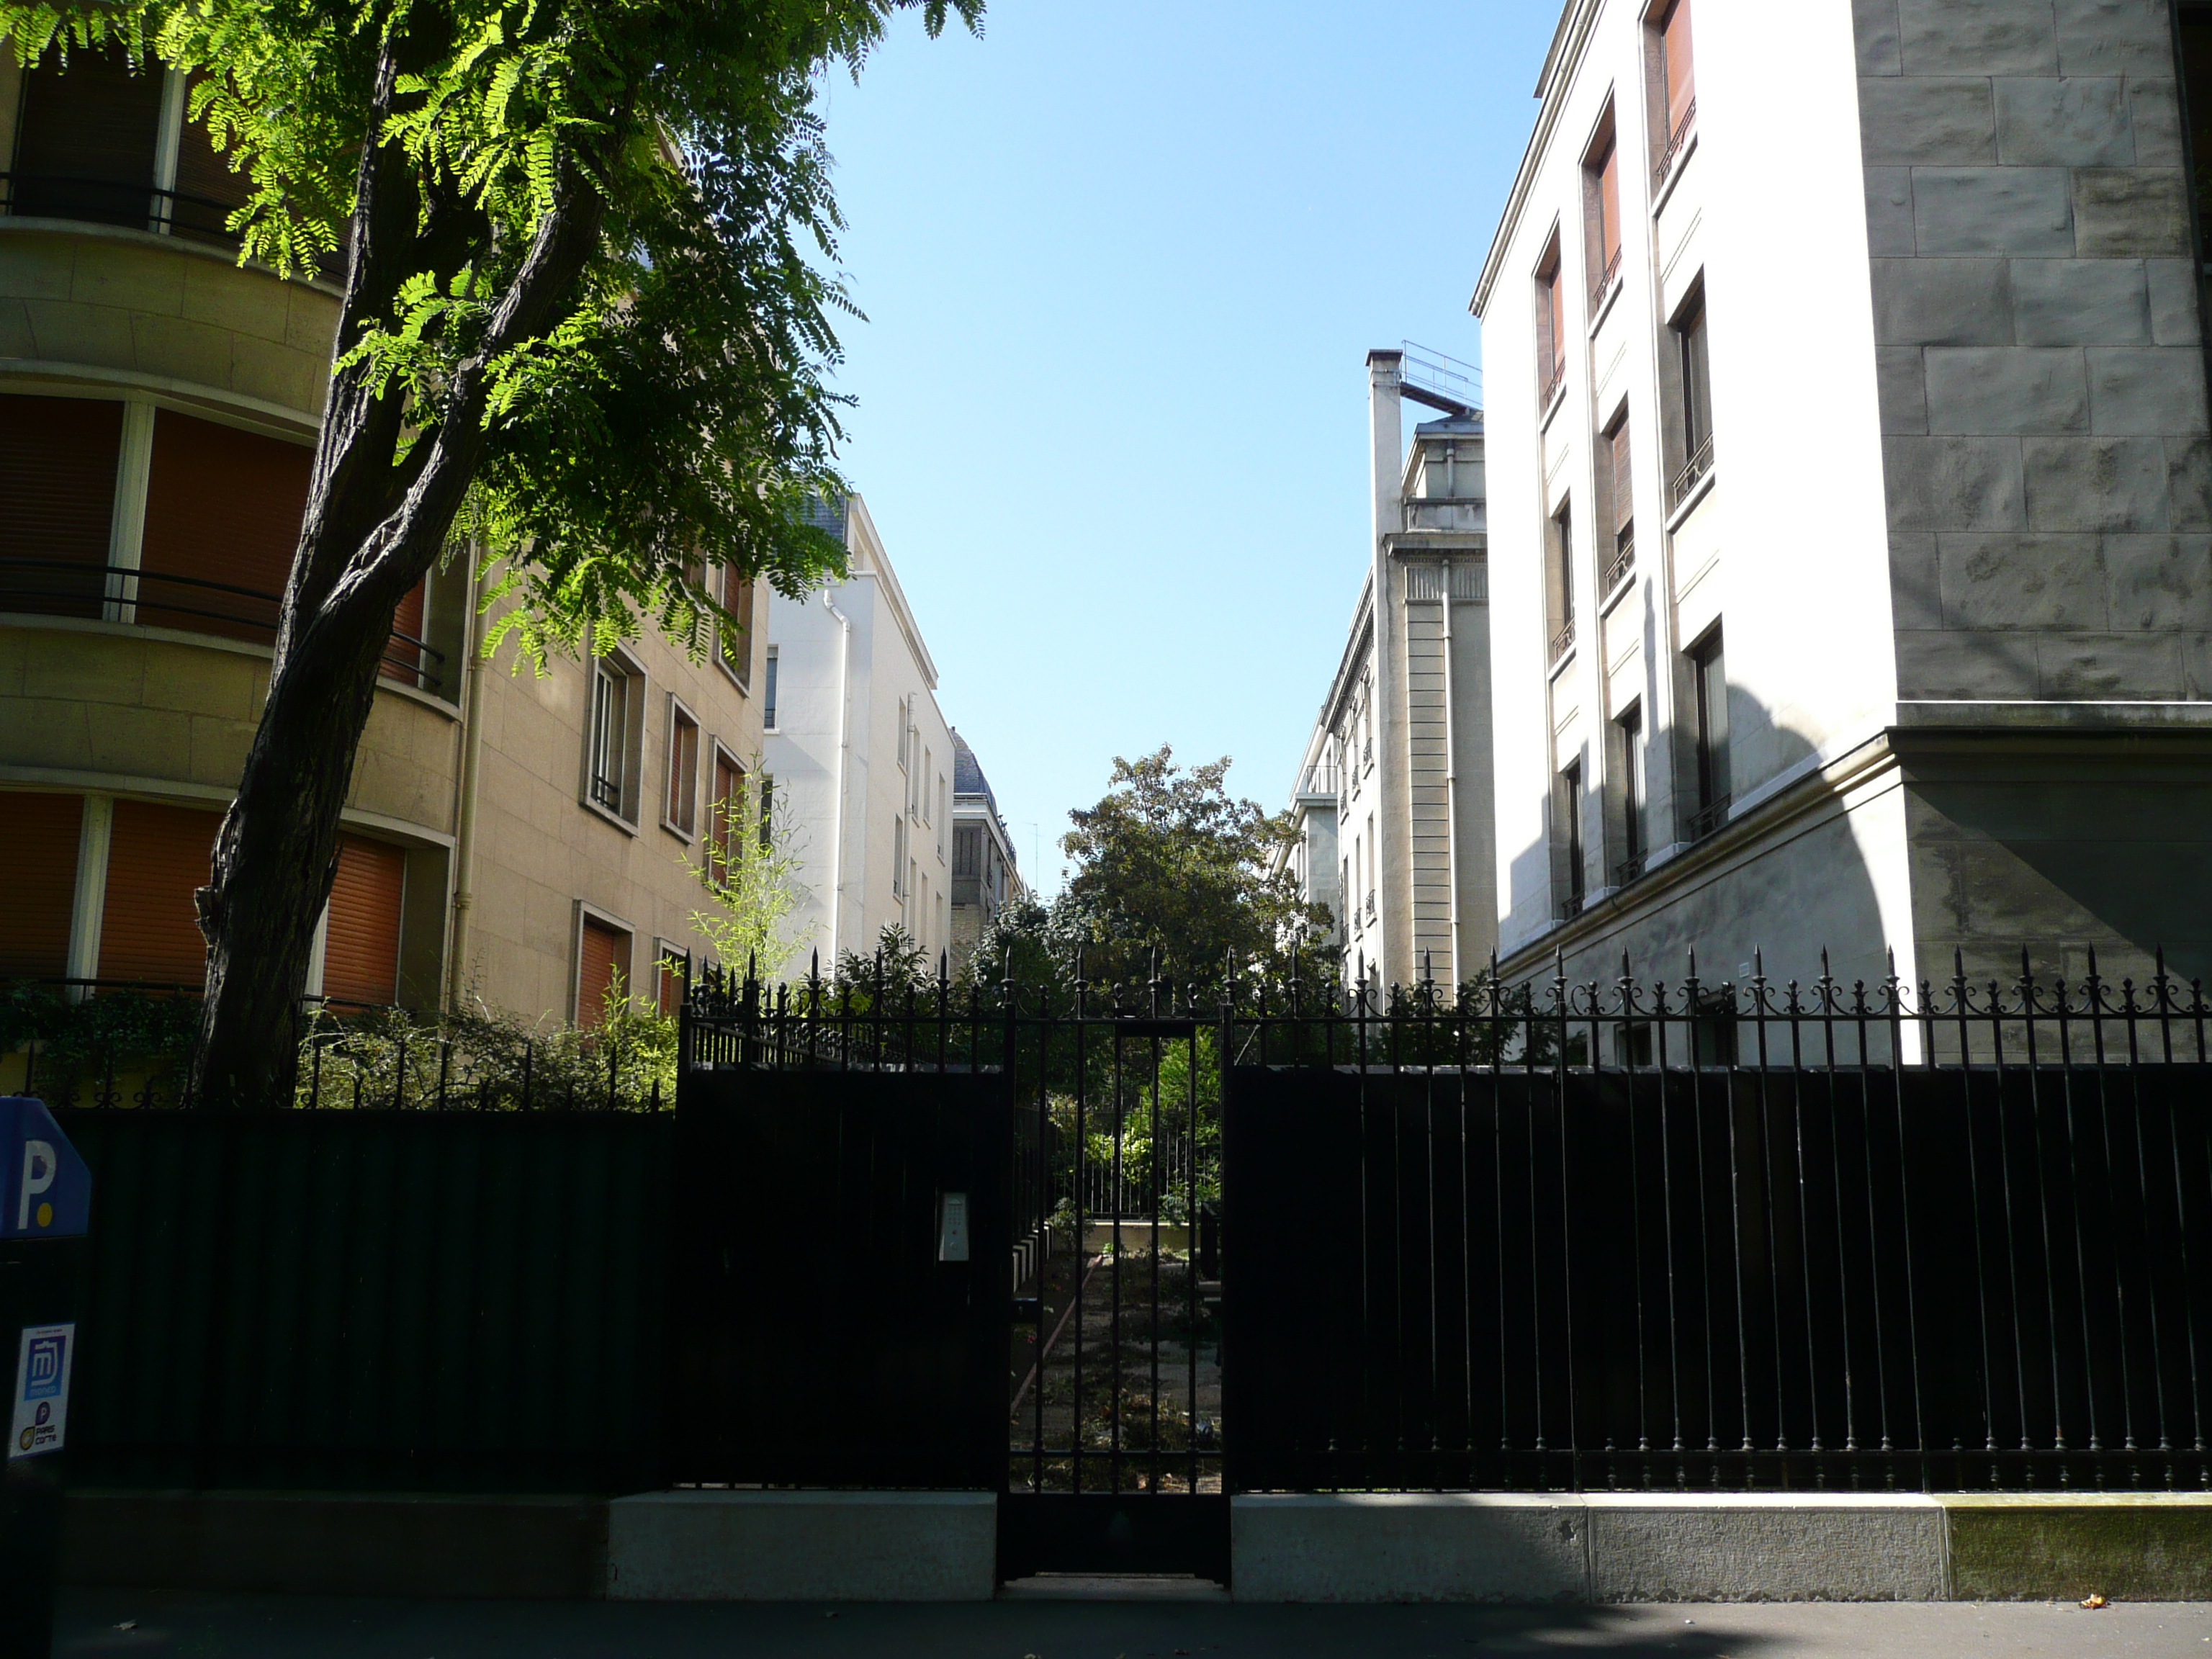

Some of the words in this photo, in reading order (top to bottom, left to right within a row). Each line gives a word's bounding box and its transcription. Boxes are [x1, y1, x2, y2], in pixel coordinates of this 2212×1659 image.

[17, 1139, 56, 1230] P
[40, 1407, 48, 1421] P
[36, 1424, 55, 1437] PARIS
